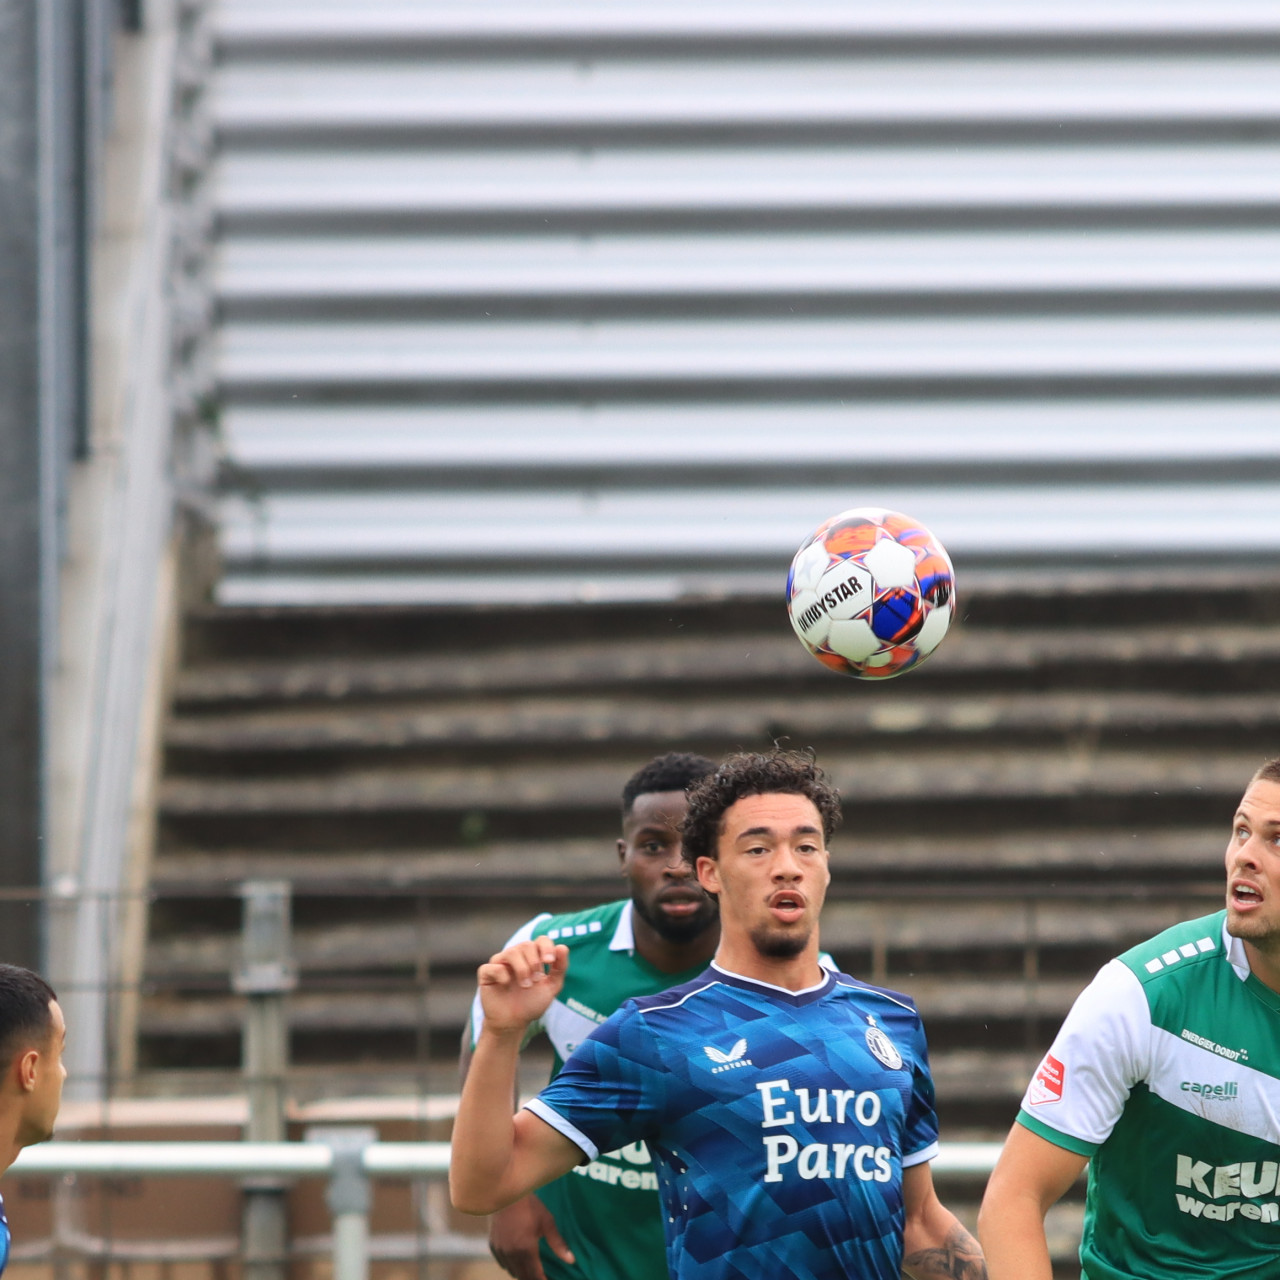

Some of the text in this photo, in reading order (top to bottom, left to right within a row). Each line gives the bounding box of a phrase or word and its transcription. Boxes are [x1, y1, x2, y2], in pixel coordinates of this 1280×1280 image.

[797, 575, 863, 633] DERBYSTAR
[756, 1079, 881, 1128] Euro
[1180, 1081, 1238, 1097] capelli
[762, 1134, 892, 1183] Parcs
